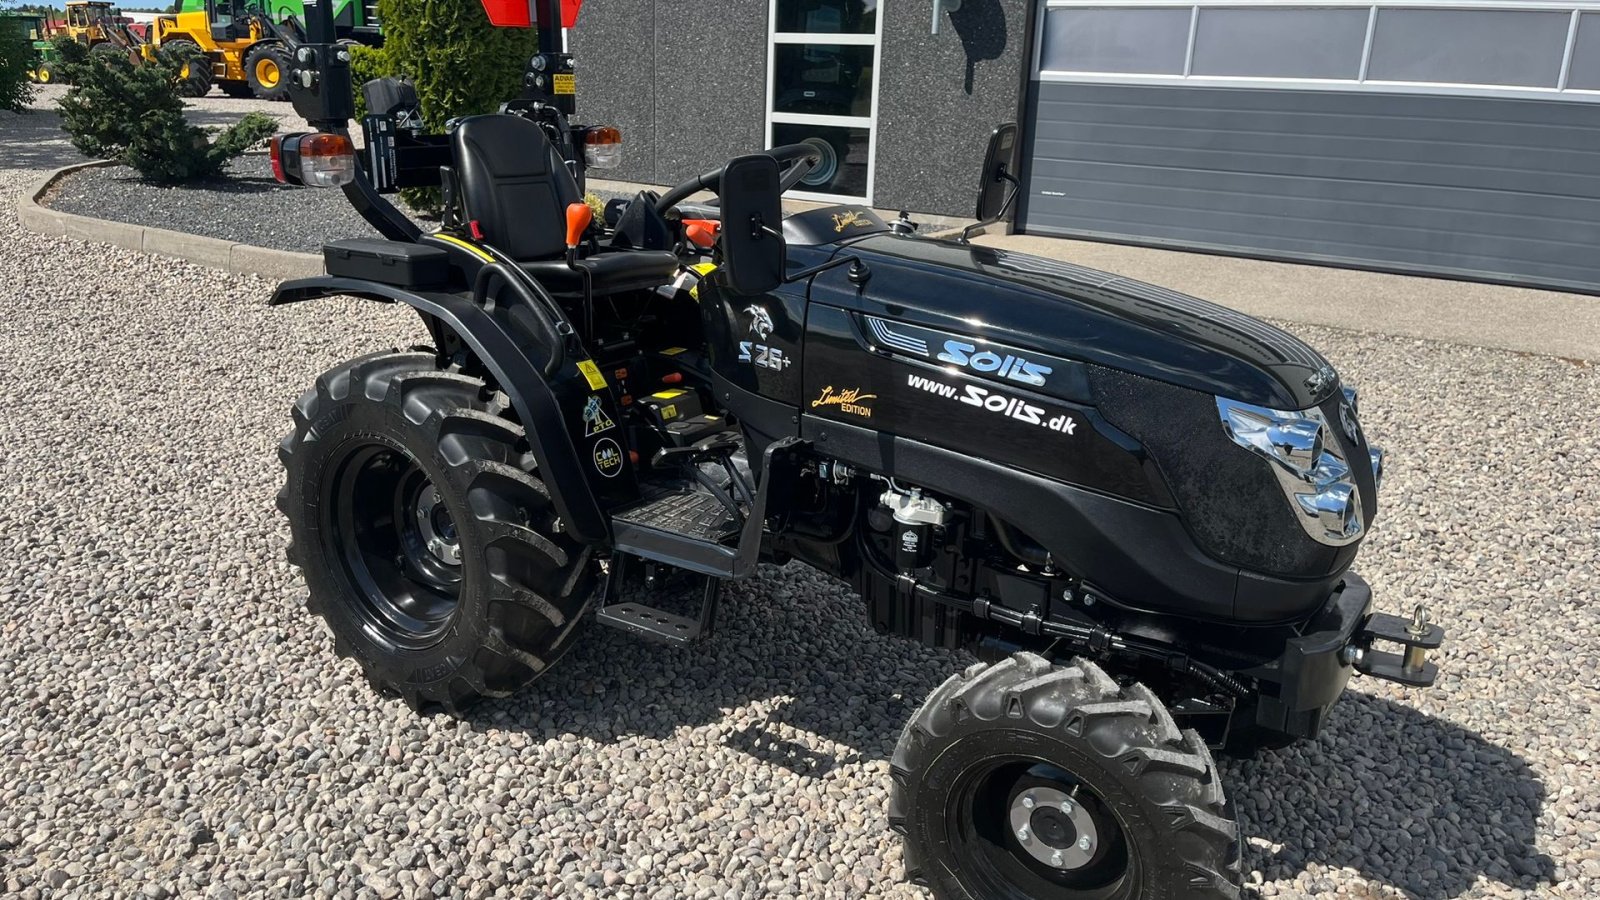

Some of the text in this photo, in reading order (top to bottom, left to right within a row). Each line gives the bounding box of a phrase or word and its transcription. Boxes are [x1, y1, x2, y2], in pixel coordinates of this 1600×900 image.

[811, 386, 877, 407] Limited
[841, 403, 871, 417] EDITION
[593, 420, 612, 433] PTO
[597, 456, 620, 469] TECH
